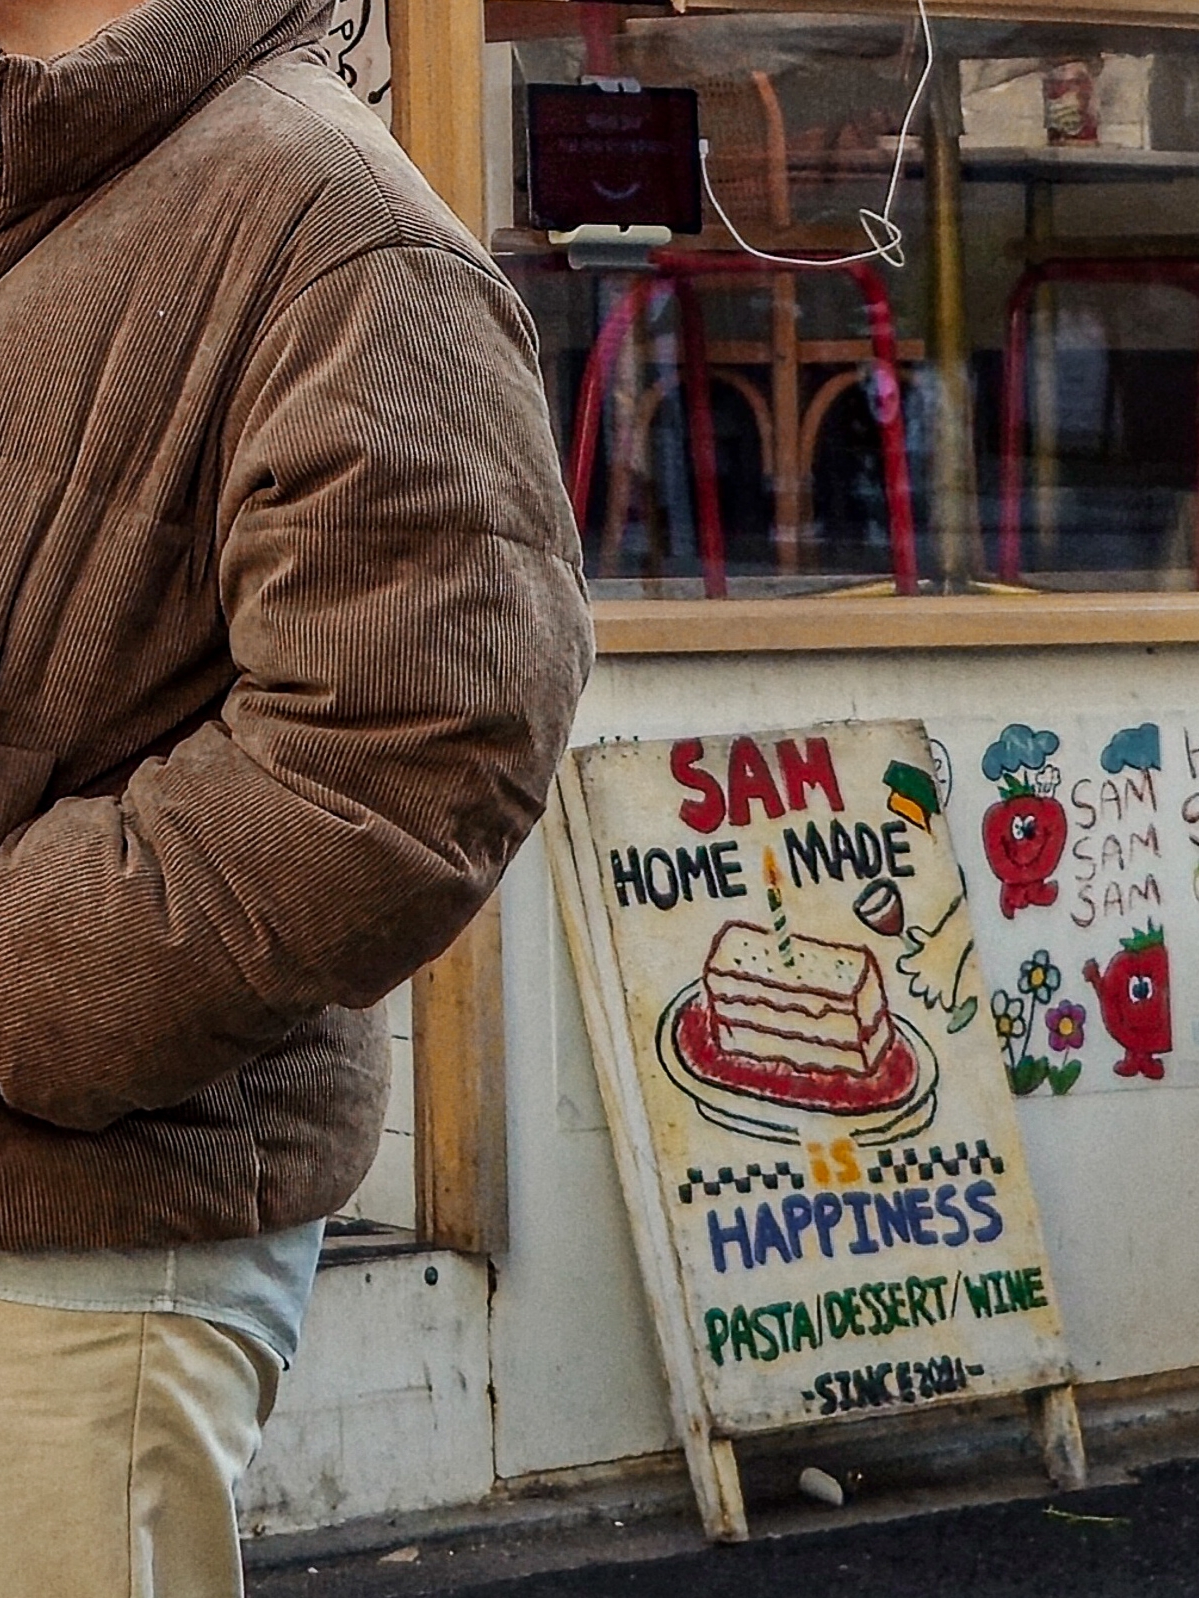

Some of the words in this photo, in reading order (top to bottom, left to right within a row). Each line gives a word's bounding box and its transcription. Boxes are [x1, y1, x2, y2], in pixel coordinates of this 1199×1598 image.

[669, 735, 845, 834] SAM
[1070, 767, 1158, 830] SAM
[610, 840, 748, 911] HOME
[783, 818, 916, 888] MADE
[1072, 822, 1162, 882] SAM
[1070, 872, 1162, 928] SAM
[706, 1179, 1004, 1274] HAPPINESS
